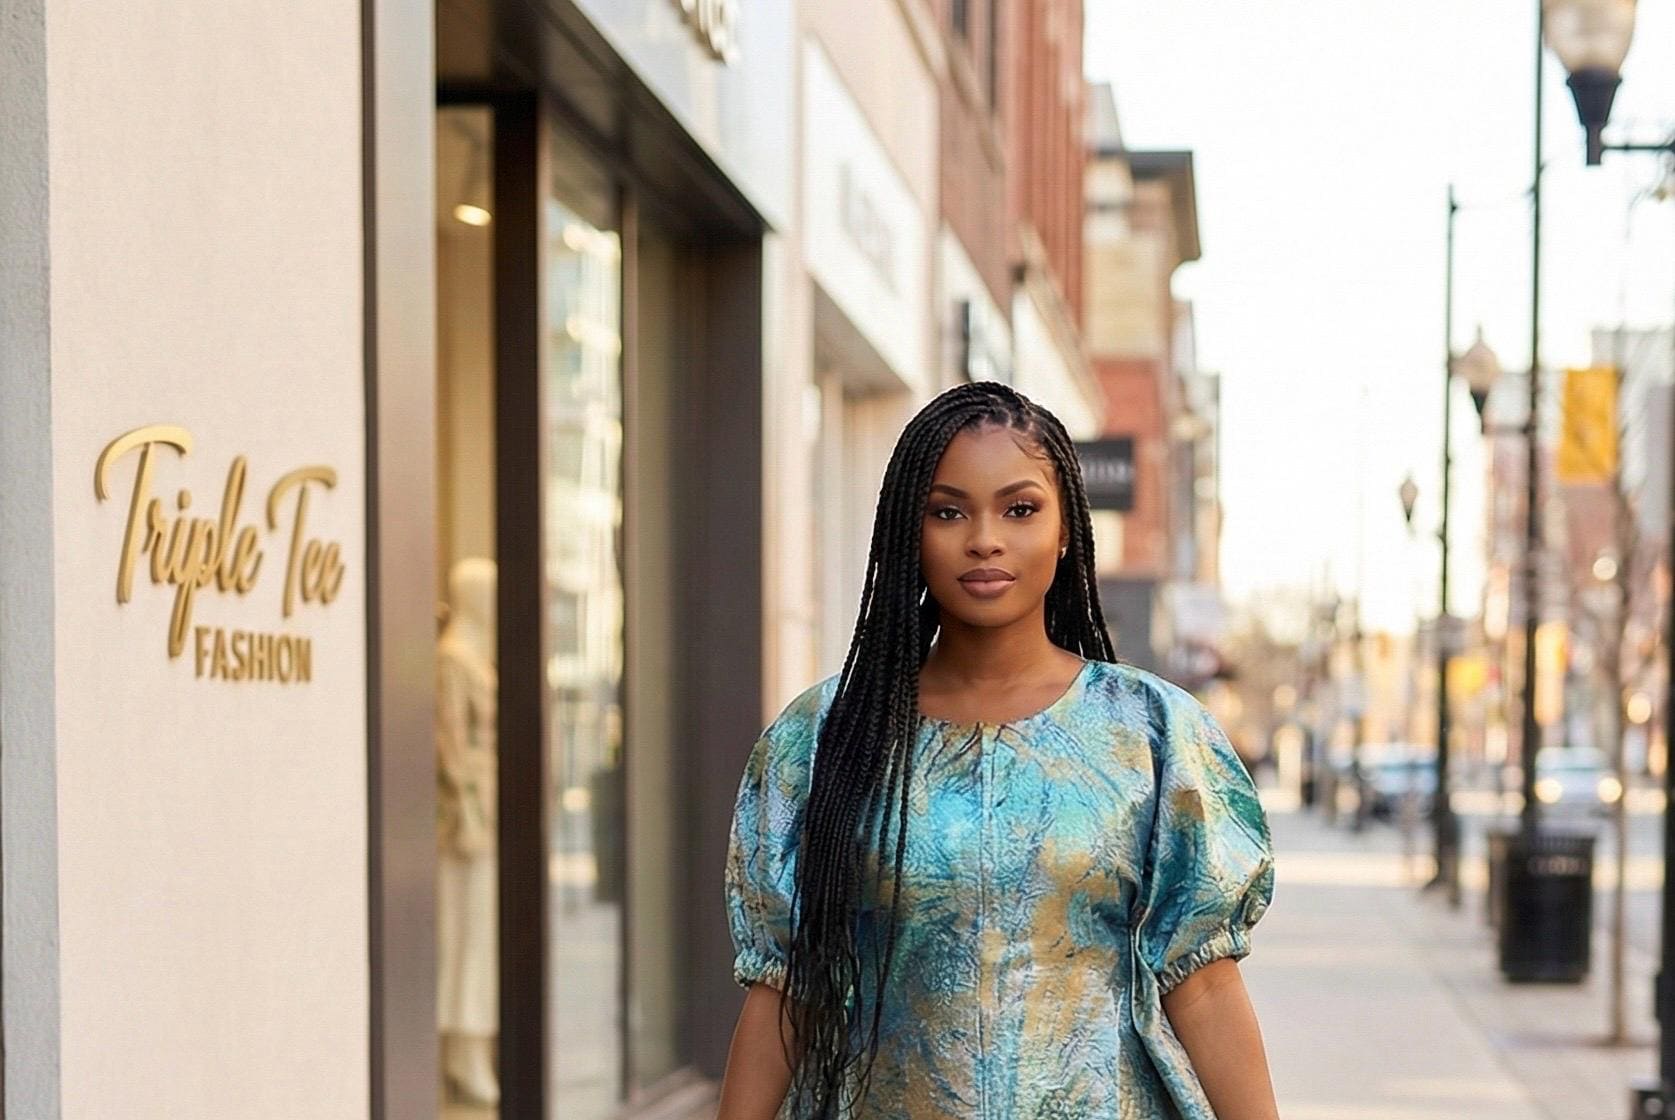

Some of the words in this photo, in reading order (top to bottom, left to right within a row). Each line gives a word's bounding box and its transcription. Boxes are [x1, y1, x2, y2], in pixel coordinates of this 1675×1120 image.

[94, 425, 263, 659] Triple
[266, 465, 345, 618] Tee
[194, 626, 312, 683] FASHION
